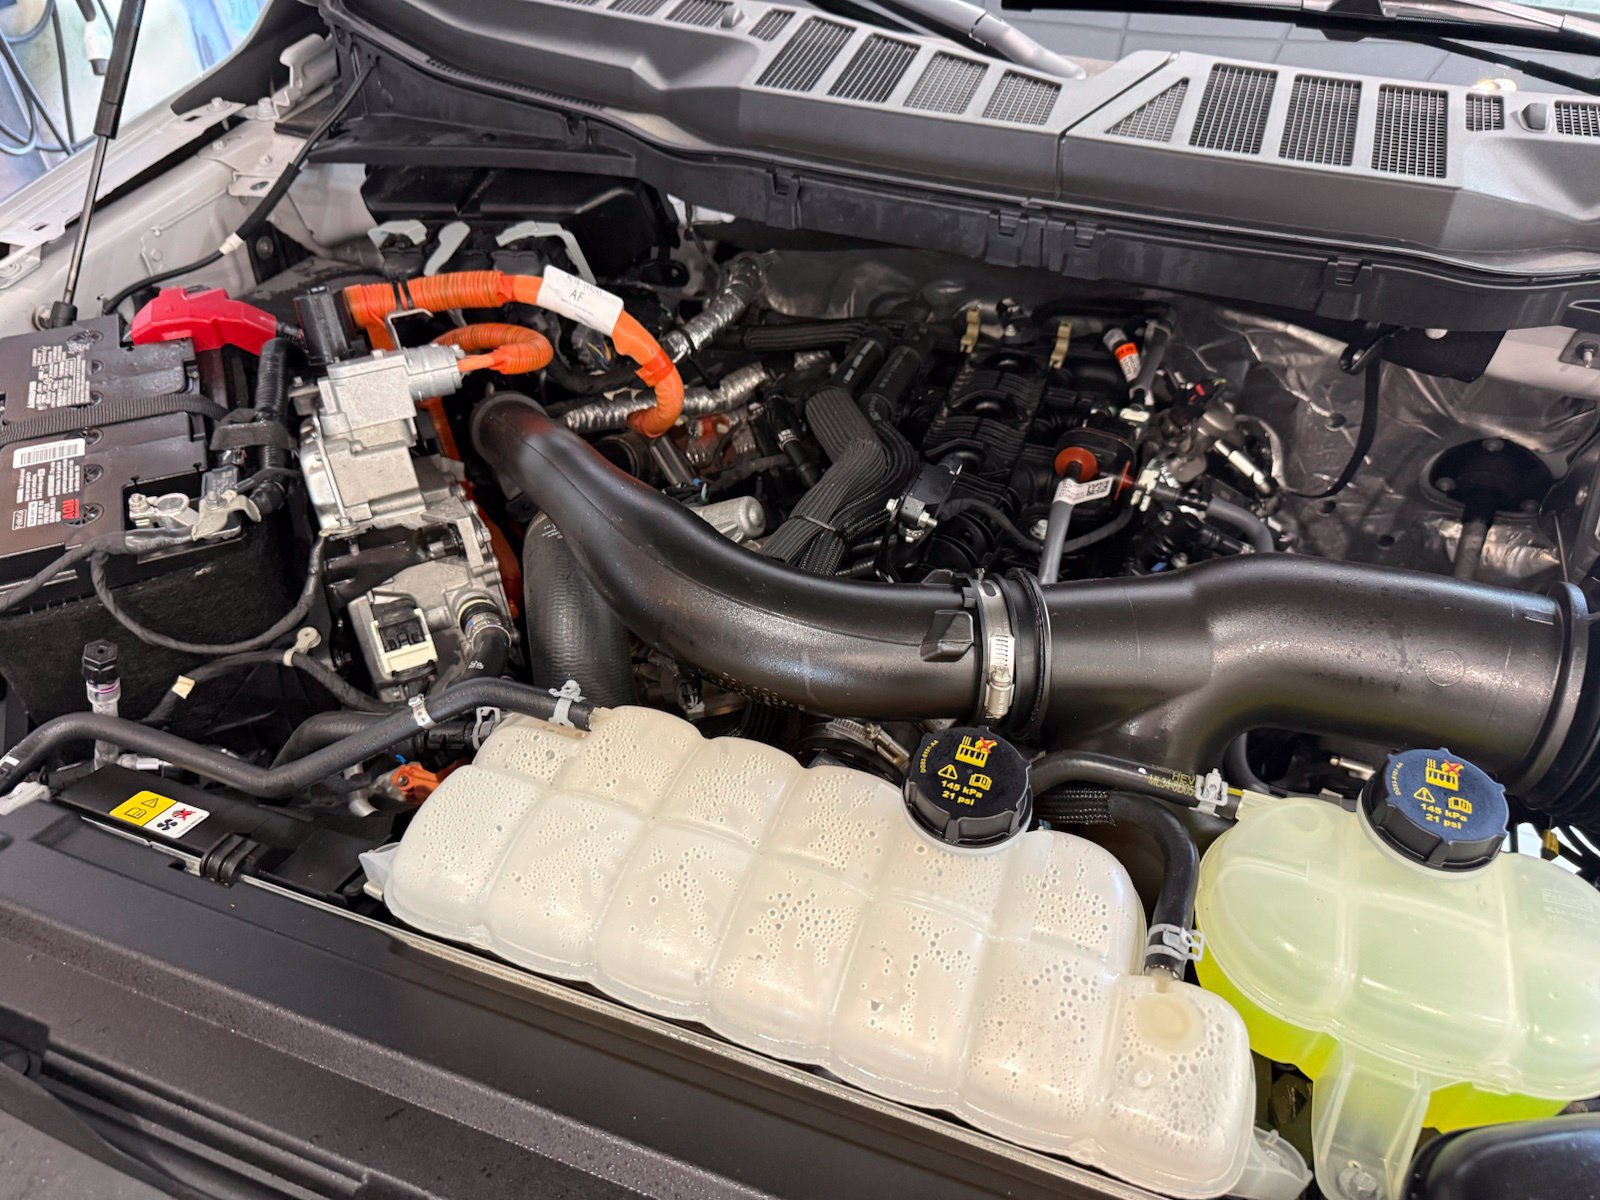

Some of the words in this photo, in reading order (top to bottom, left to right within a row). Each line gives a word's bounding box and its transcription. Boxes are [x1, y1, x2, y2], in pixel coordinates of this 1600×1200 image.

[568, 288, 587, 303] AF
[62, 499, 75, 519] AGM
[1171, 770, 1197, 785] HEV
[941, 780, 961, 791] 145
[962, 786, 983, 799] kPa
[942, 790, 955, 800] 21
[957, 796, 975, 806] psi
[1420, 803, 1442, 815] 145
[1445, 810, 1468, 822] kPa
[1425, 813, 1440, 823] 21
[1443, 819, 1462, 830] psi
